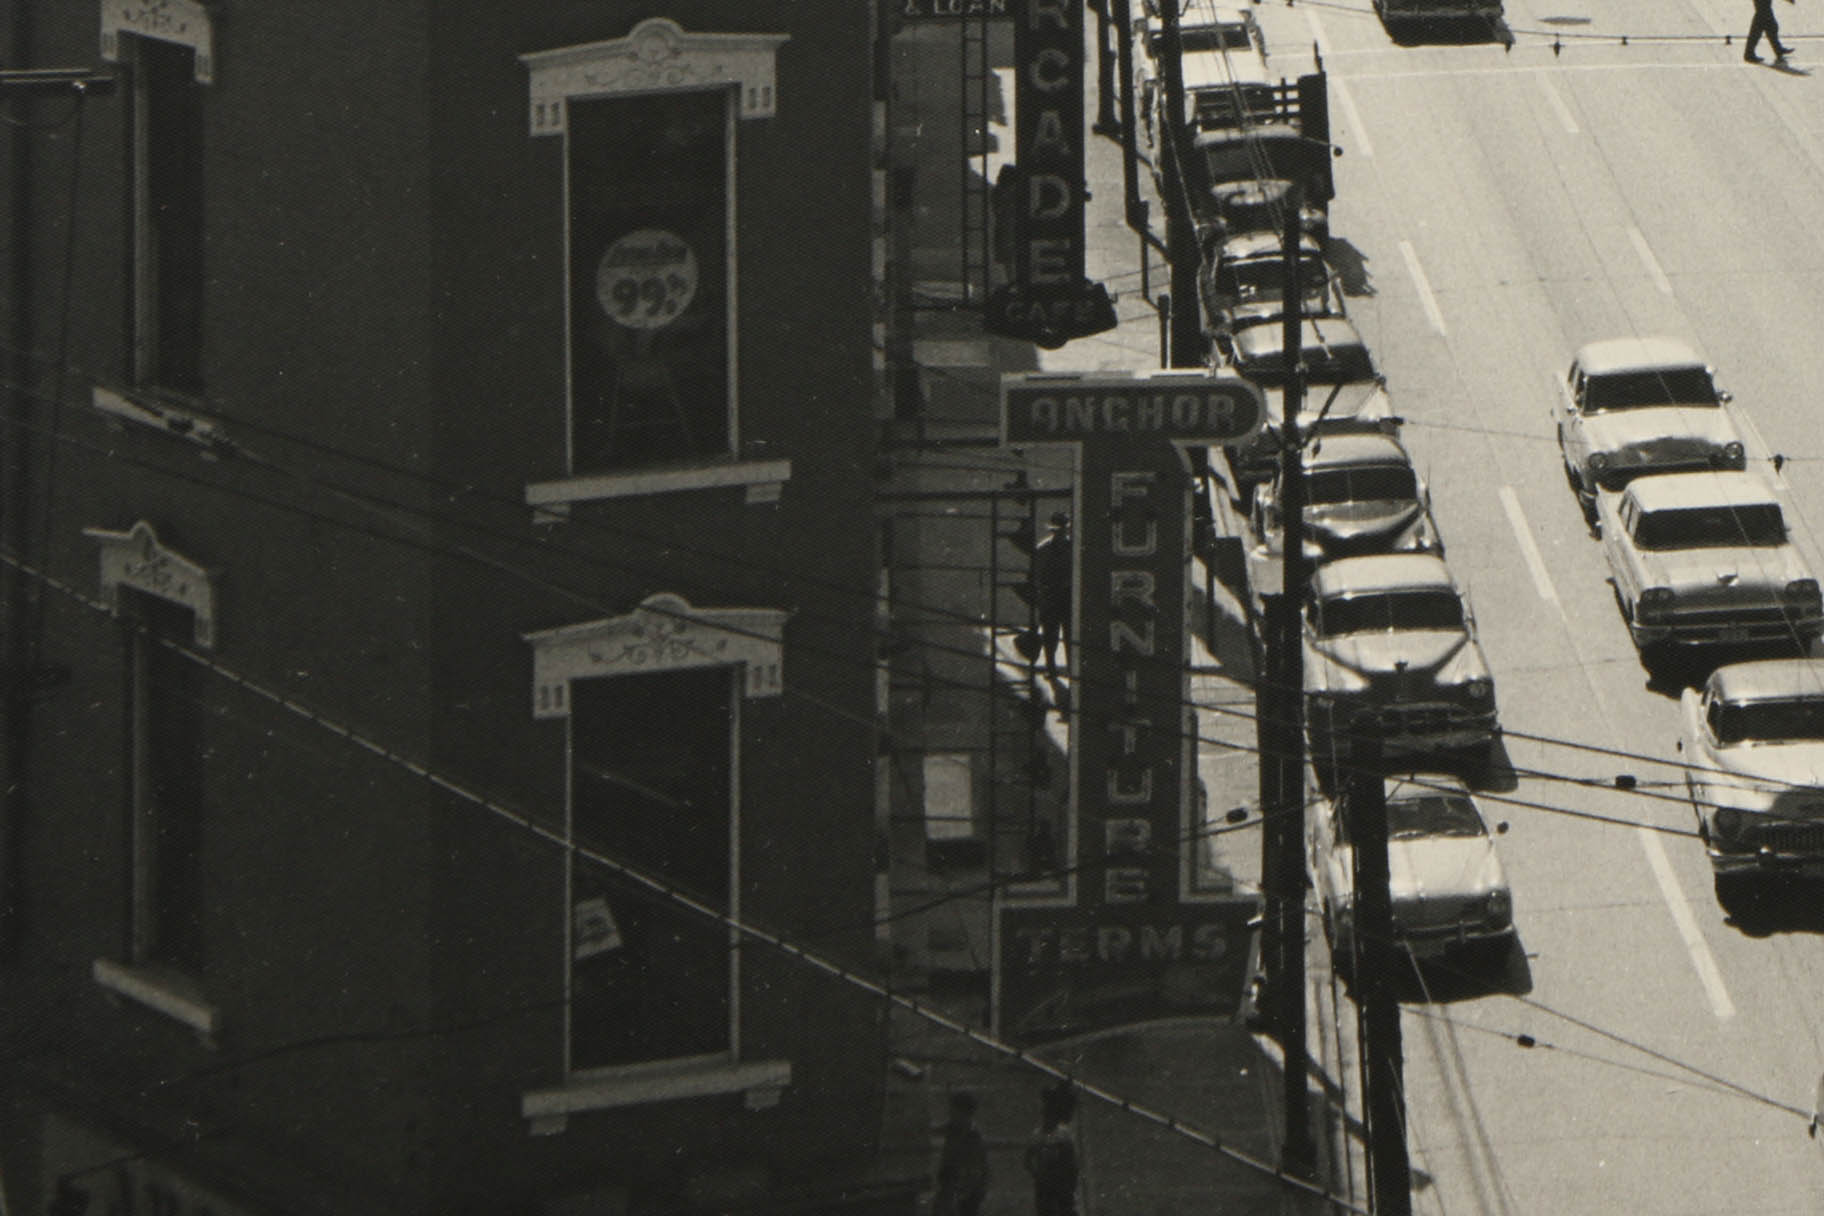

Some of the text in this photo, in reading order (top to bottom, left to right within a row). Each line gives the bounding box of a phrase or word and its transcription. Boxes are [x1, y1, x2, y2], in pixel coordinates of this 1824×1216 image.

[1032, 394, 1236, 432] ANCHOR
[1107, 472, 1158, 904] FURNITURE
[1015, 922, 1229, 964] TERMS
